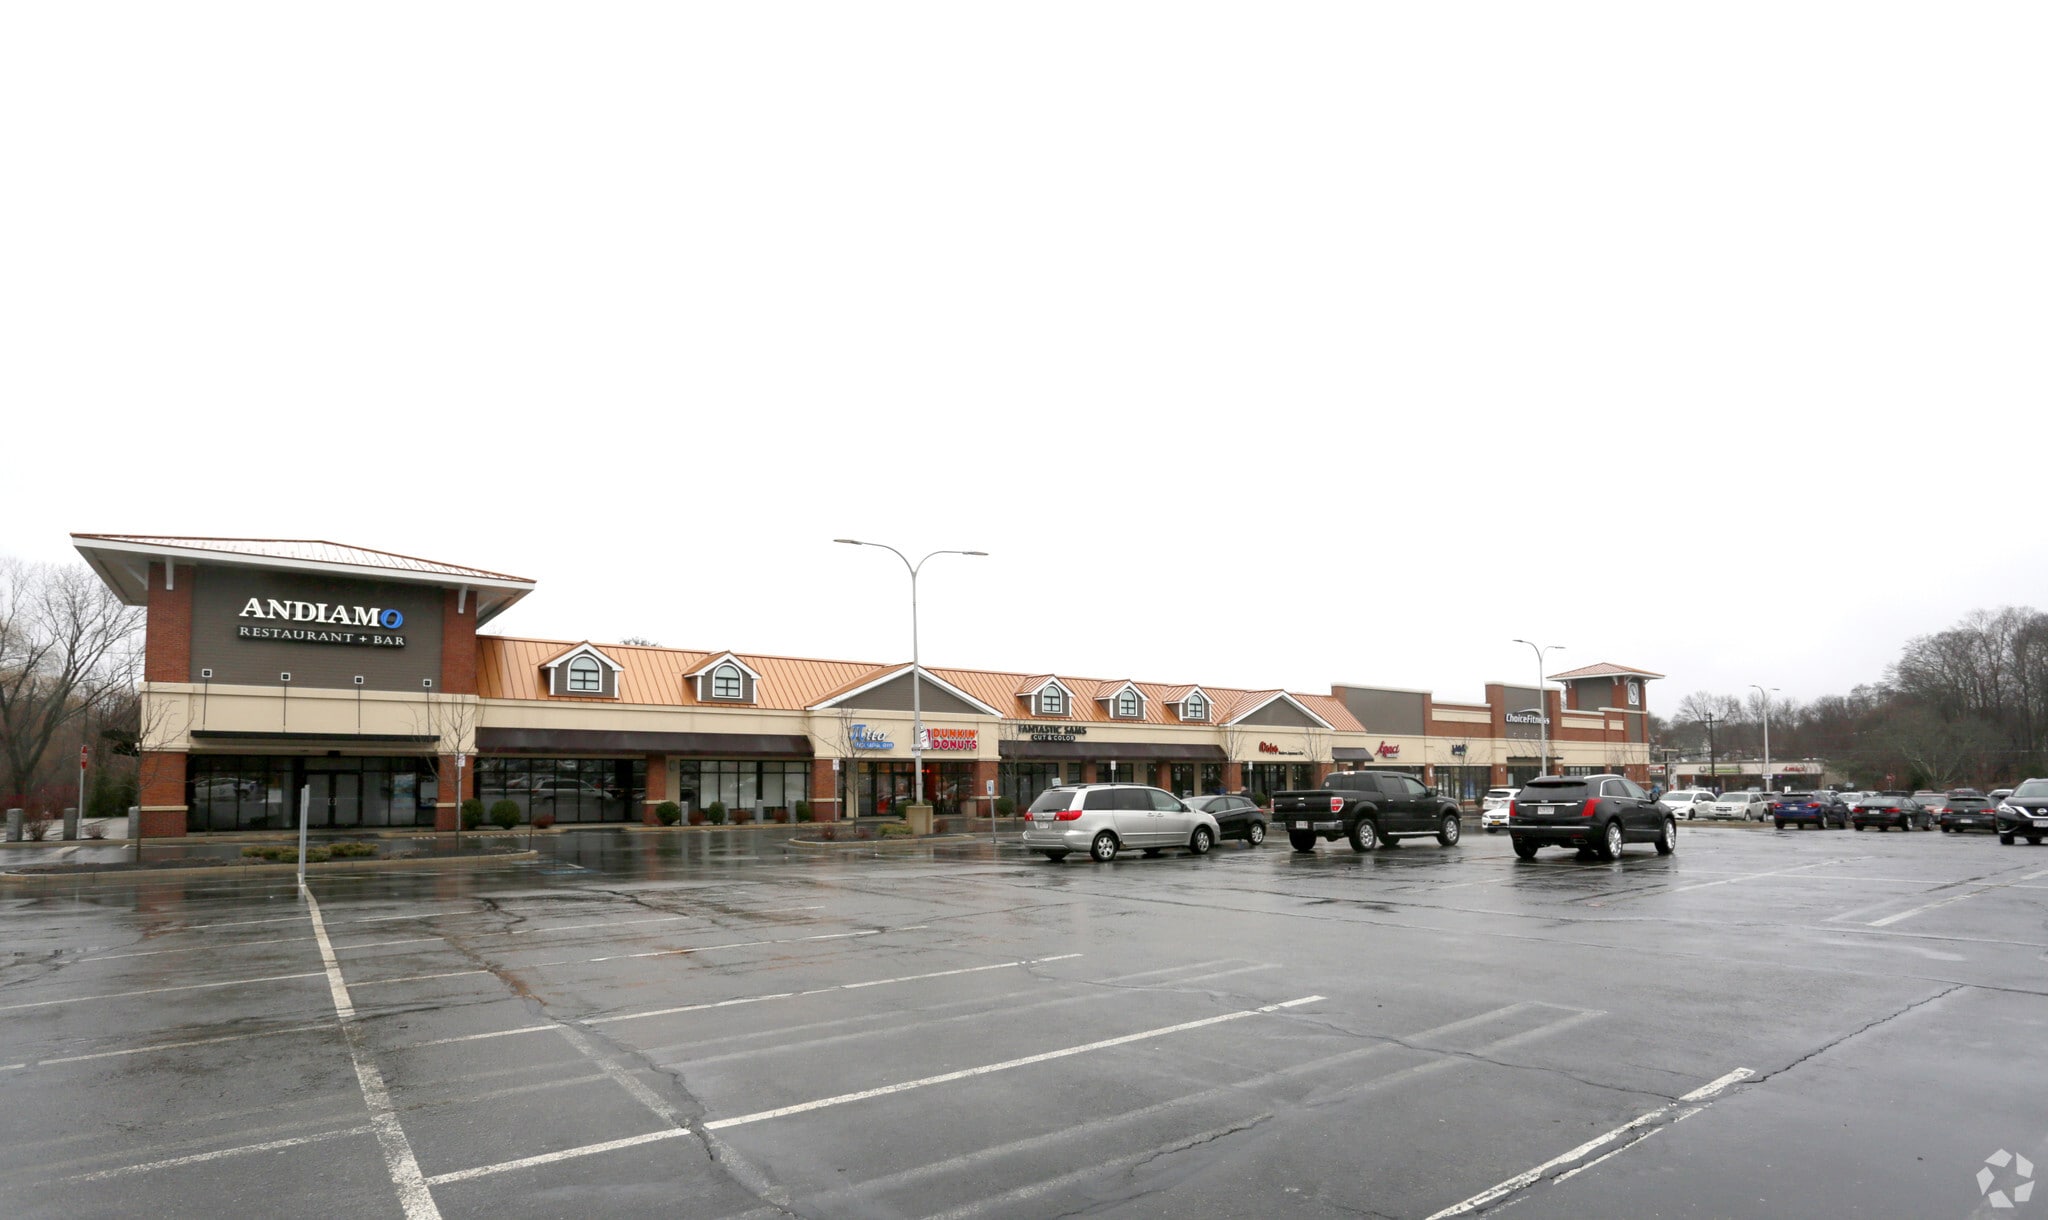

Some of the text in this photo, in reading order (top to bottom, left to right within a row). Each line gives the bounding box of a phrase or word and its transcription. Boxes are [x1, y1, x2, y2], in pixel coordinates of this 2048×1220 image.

[239, 597, 403, 629] ANDIAMO
[239, 626, 354, 643] RESTAURANT
[373, 635, 405, 646] BAR
[932, 728, 978, 739] DUNKIN'
[1018, 724, 1087, 735] FANTASTIC SAMS
[932, 740, 977, 750] DONUTS
